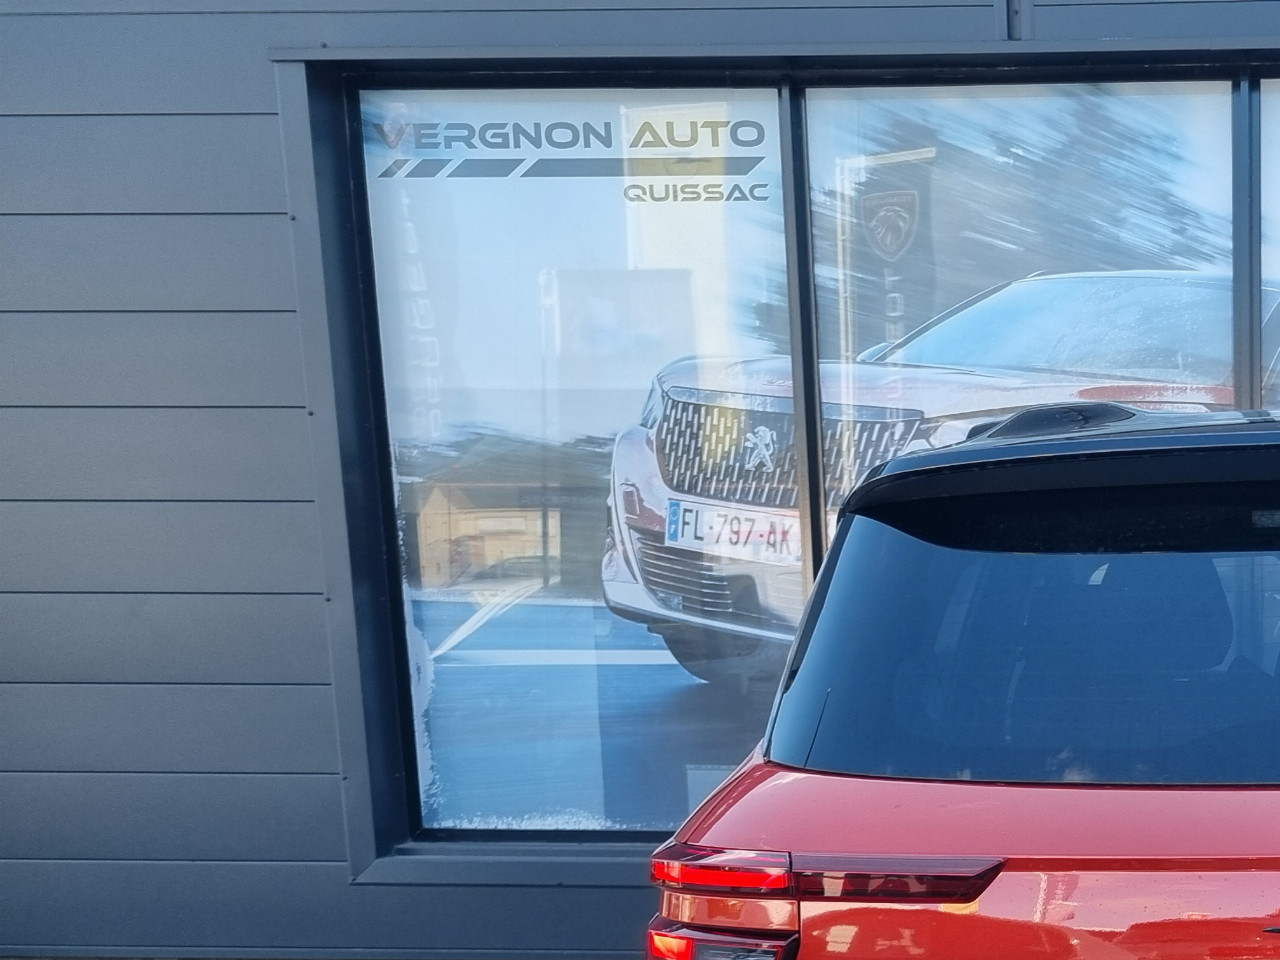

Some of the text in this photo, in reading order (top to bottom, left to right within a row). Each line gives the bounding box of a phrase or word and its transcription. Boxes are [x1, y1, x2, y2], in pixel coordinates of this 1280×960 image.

[372, 119, 766, 151] VERGNON AUTO
[623, 182, 771, 203] QUISSAC
